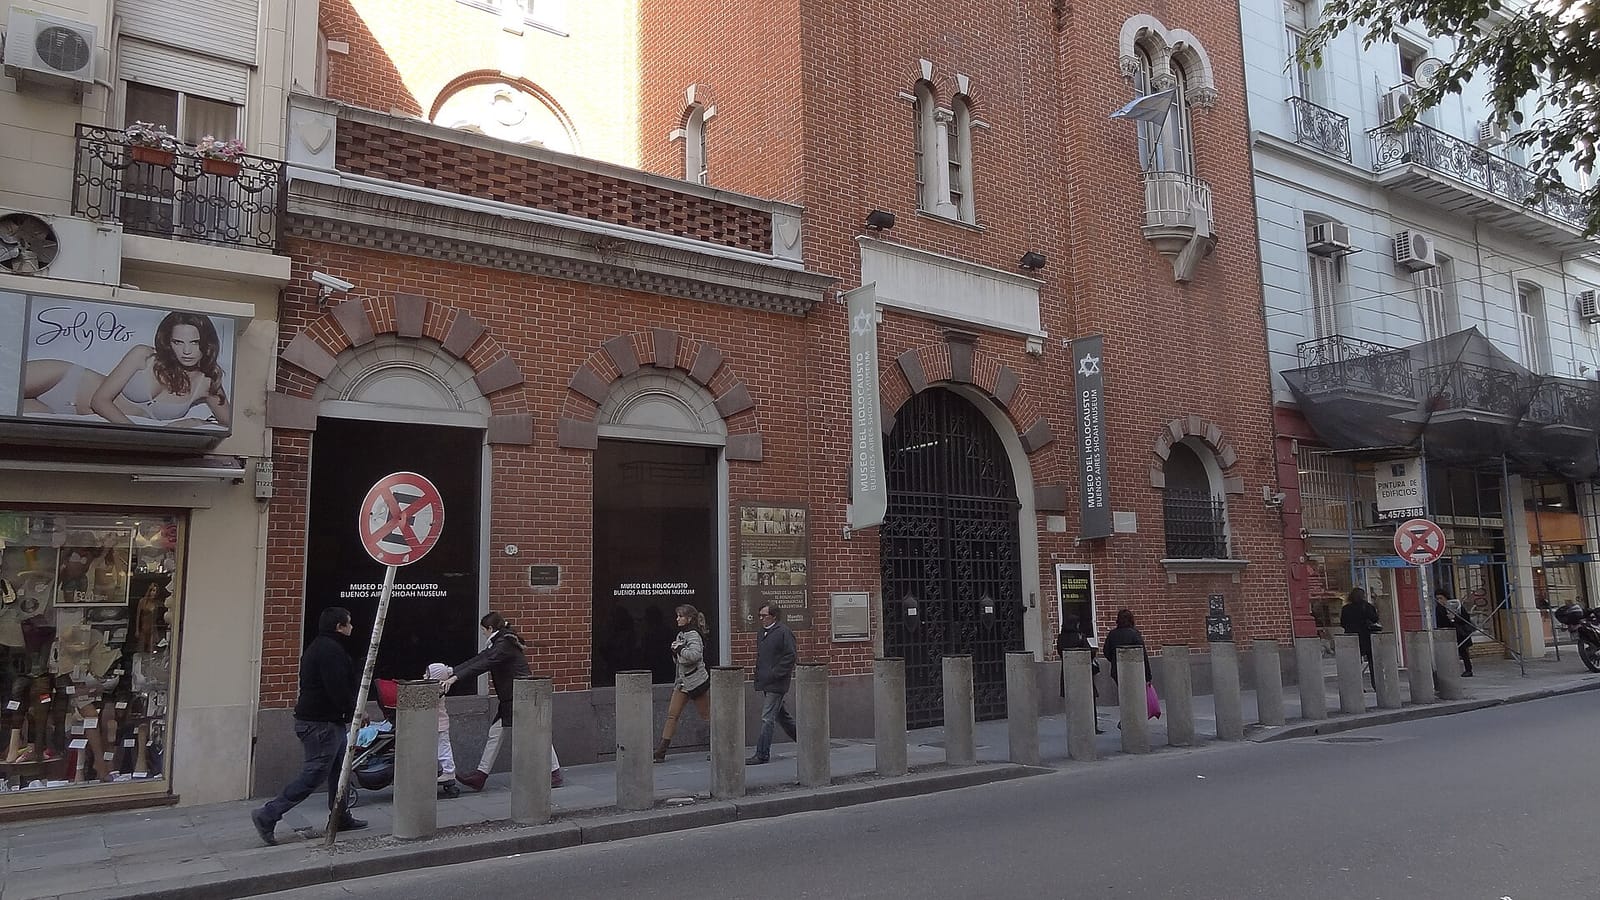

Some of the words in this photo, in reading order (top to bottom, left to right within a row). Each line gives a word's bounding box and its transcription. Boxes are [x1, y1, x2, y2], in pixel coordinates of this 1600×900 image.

[96, 311, 136, 342] Oro
[856, 353, 867, 426] HOLOCAUSTO
[1083, 390, 1092, 453] HOLOCAUSTO
[1091, 389, 1099, 423] MUSEUM
[859, 427, 867, 449] DEL
[868, 428, 876, 453] AIRES
[860, 452, 870, 491] MUSEO
[869, 454, 877, 491] BUENOS
[1085, 455, 1093, 472] DEL
[1086, 474, 1095, 508] MUSEO
[1095, 475, 1103, 508] BUENOS
[1378, 480, 1406, 490] PINTURA
[1410, 479, 1417, 487] DE
[1382, 488, 1417, 498] EDIFICIOS
[391, 590, 416, 598] SHOAH
